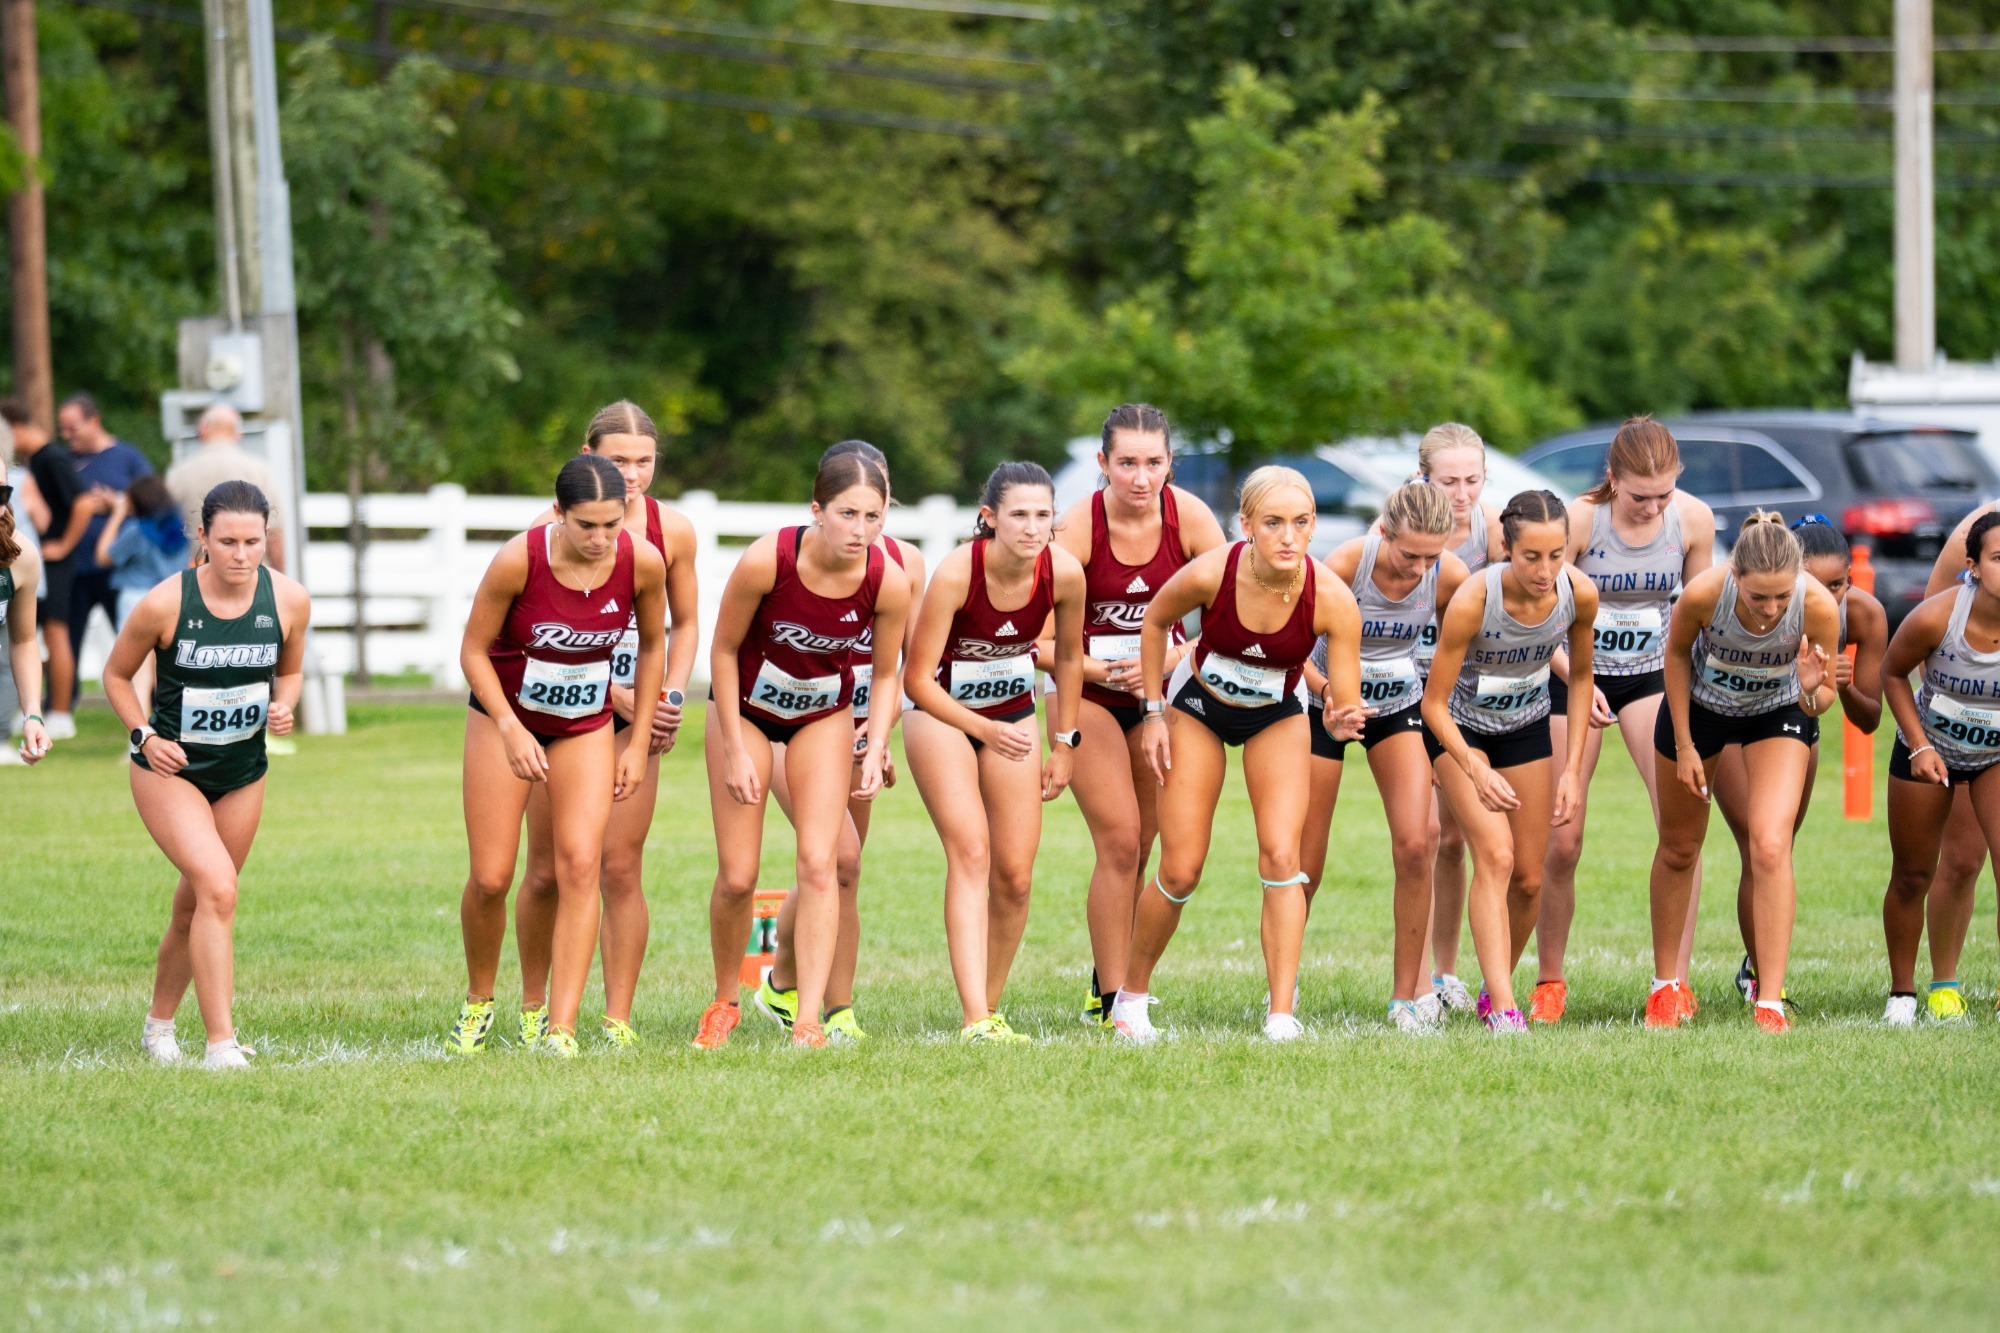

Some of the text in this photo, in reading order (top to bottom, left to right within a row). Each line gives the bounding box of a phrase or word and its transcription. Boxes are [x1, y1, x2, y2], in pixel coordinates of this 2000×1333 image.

[1126, 585, 1149, 594] adidas
[1588, 573, 1637, 592] TON
[1092, 601, 1150, 630] RID
[526, 622, 622, 654] RIDER
[769, 621, 858, 654] RIDER
[995, 629, 1018, 637] adidas
[175, 639, 278, 669] LOYOLA
[954, 638, 1037, 660] RIDE
[1242, 650, 1266, 658] adidas
[1475, 643, 1559, 665] SETON HA
[983, 661, 1013, 673] LEXICON
[989, 669, 1013, 678] TIMING
[1234, 664, 1264, 679] LEXICON
[957, 677, 1026, 701] 2886
[1240, 675, 1262, 687] TIMING
[1361, 680, 1405, 701] 905
[1712, 670, 1781, 693] 2906
[1933, 669, 1985, 698] SETON
[216, 688, 247, 700] LEXICON
[223, 696, 247, 706] TIMING
[529, 682, 598, 707] 2883
[760, 684, 829, 711] 2884
[1478, 687, 1541, 711] 2912
[190, 704, 260, 732] 2849
[1185, 699, 1206, 716] adidas
[1961, 709, 1993, 720] LEXICON
[1933, 715, 2000, 747] 2908
[1966, 716, 1991, 726] TIMING
